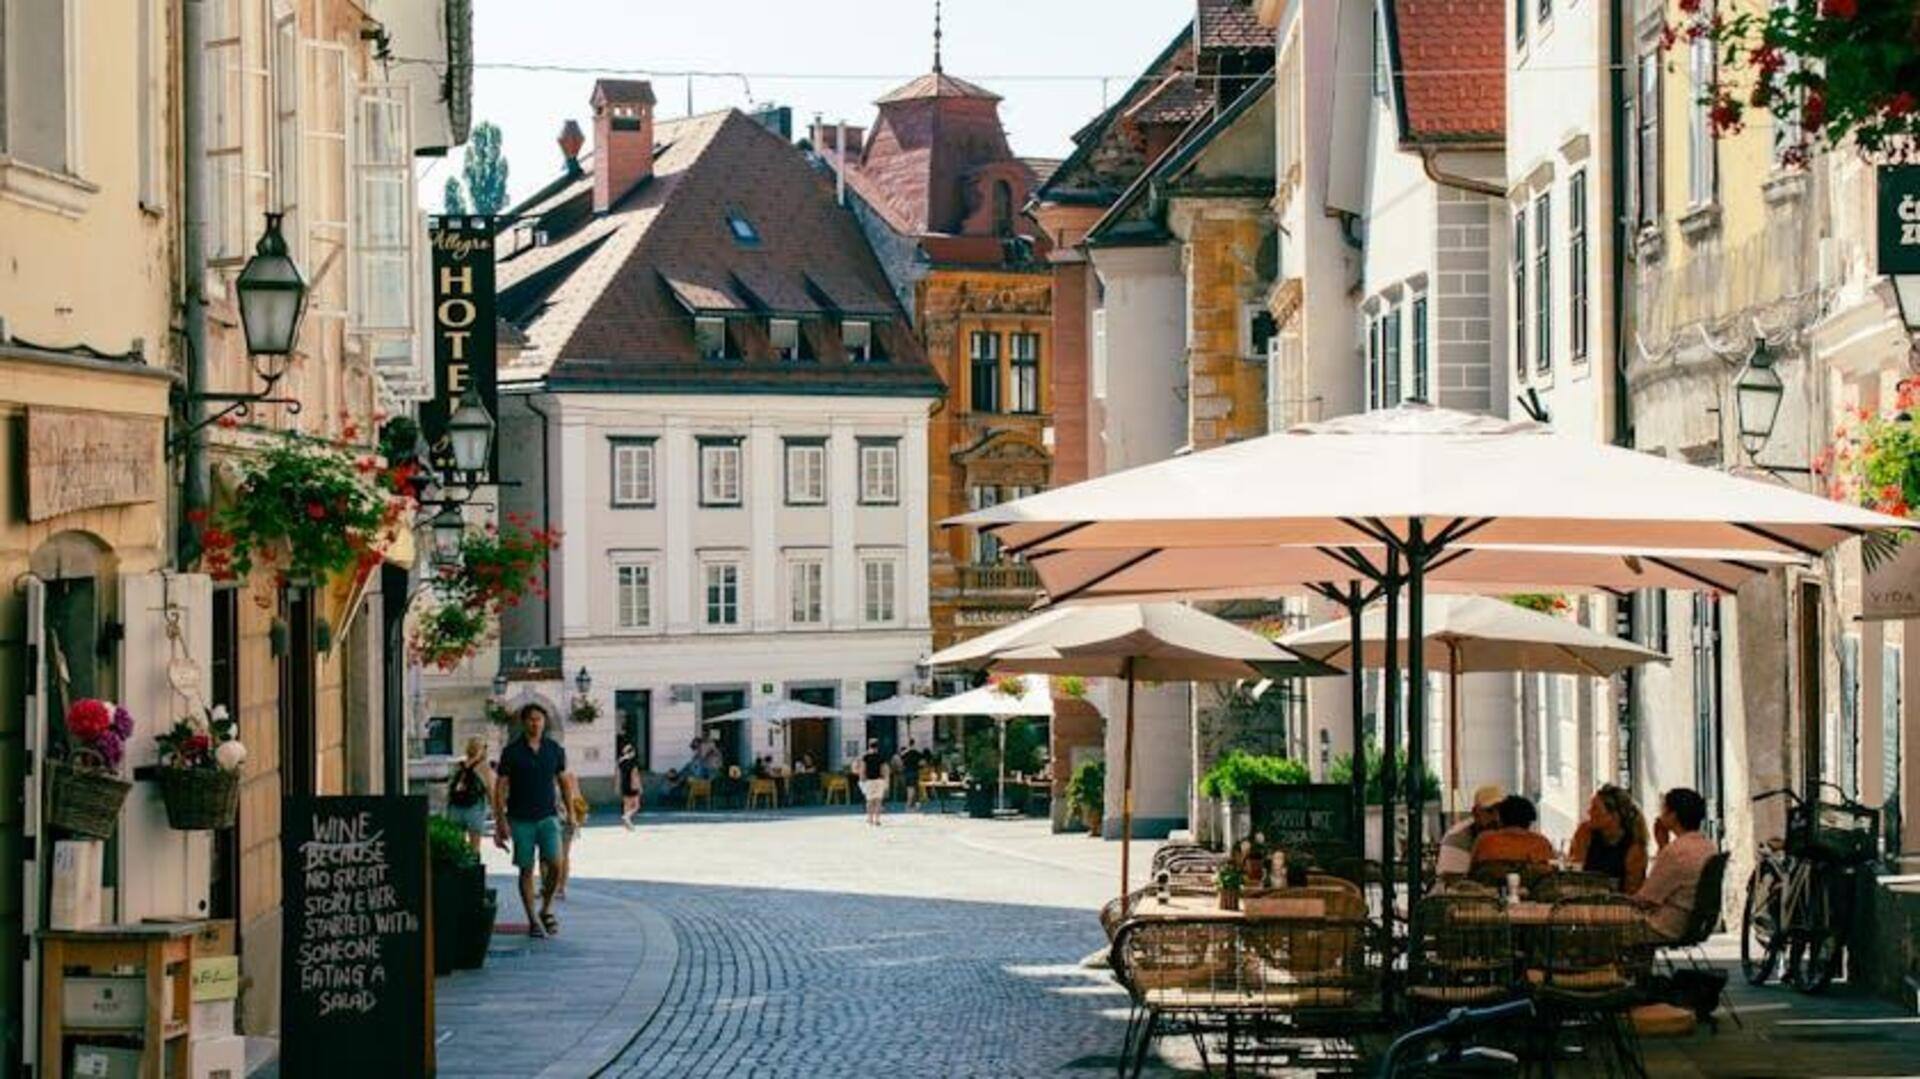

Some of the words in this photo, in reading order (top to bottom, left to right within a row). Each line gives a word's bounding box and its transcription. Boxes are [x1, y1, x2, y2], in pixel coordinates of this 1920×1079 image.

[1898, 194, 1920, 221] Č
[430, 229, 492, 260] Allegro
[1869, 590, 1915, 603] VIDA
[312, 812, 371, 841] WINE
[303, 842, 385, 870] BECAUSE
[306, 870, 331, 891] NO
[333, 863, 391, 892] GREAT
[304, 890, 352, 916] STORY
[355, 885, 396, 911] EVER
[304, 914, 370, 939] STARTED
[374, 911, 418, 933] WITH
[297, 936, 381, 965] SOMEONE
[301, 964, 366, 989] EATING
[370, 965, 385, 981] A
[319, 990, 378, 1016] SALAD
